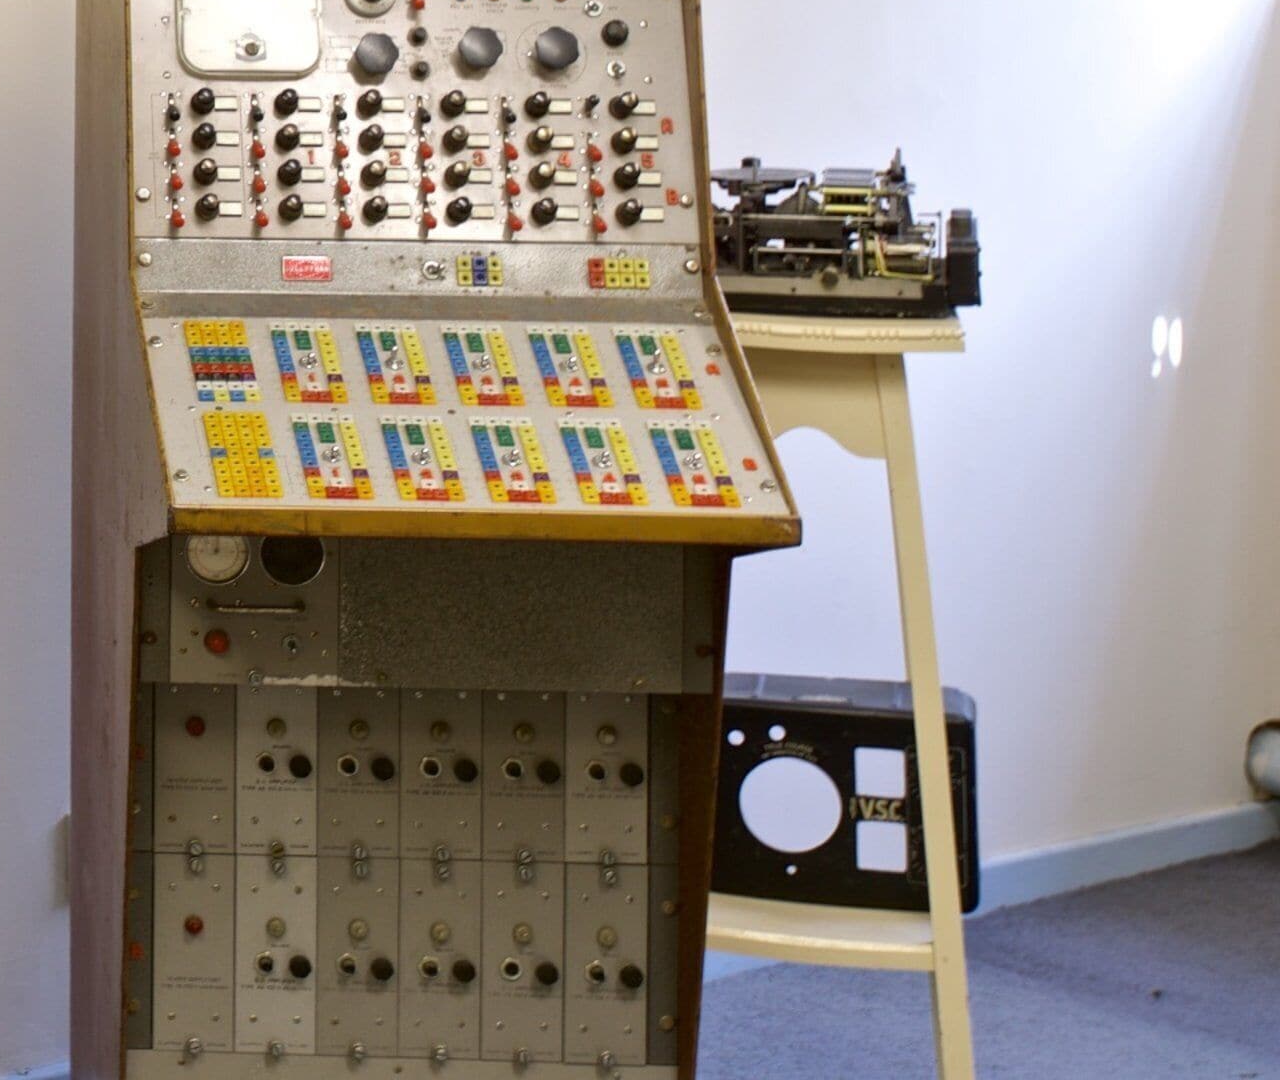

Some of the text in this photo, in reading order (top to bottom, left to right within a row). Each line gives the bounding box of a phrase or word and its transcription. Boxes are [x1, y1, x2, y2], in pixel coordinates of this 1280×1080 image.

[308, 151, 314, 164] 1
[389, 152, 402, 165] 2
[472, 152, 486, 166] 3
[558, 152, 571, 168] 4
[641, 152, 654, 168] 5
